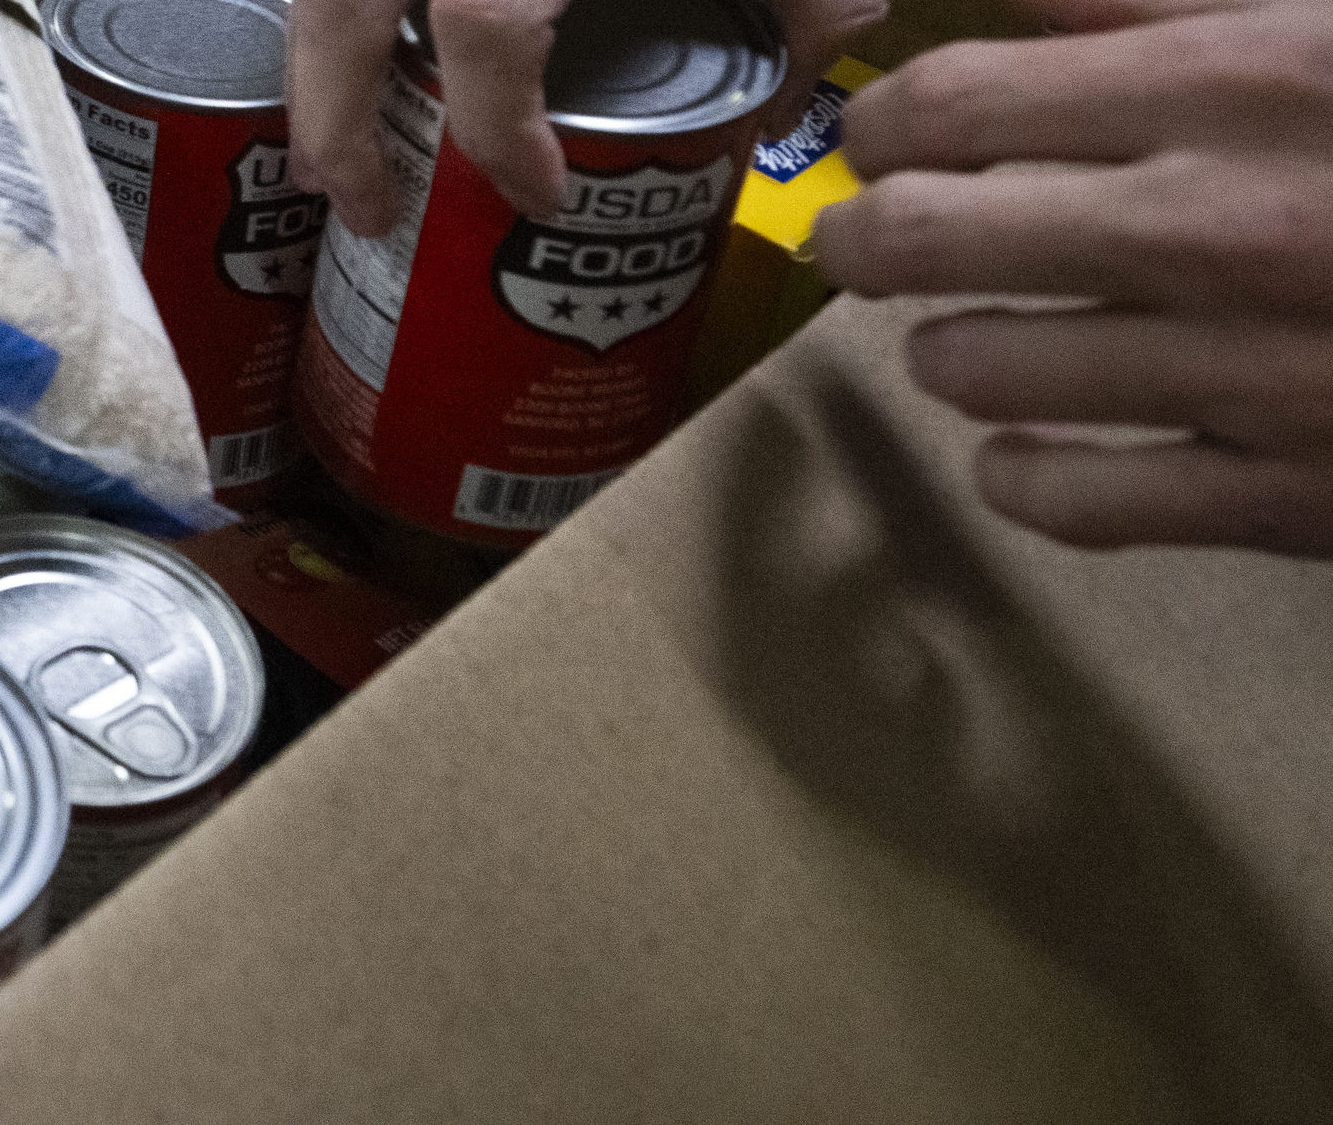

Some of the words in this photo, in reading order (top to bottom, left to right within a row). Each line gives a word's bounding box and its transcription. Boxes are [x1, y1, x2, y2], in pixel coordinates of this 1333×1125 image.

[87, 103, 150, 140] Facts
[106, 181, 148, 207] 450
[529, 230, 704, 277] FOOD
